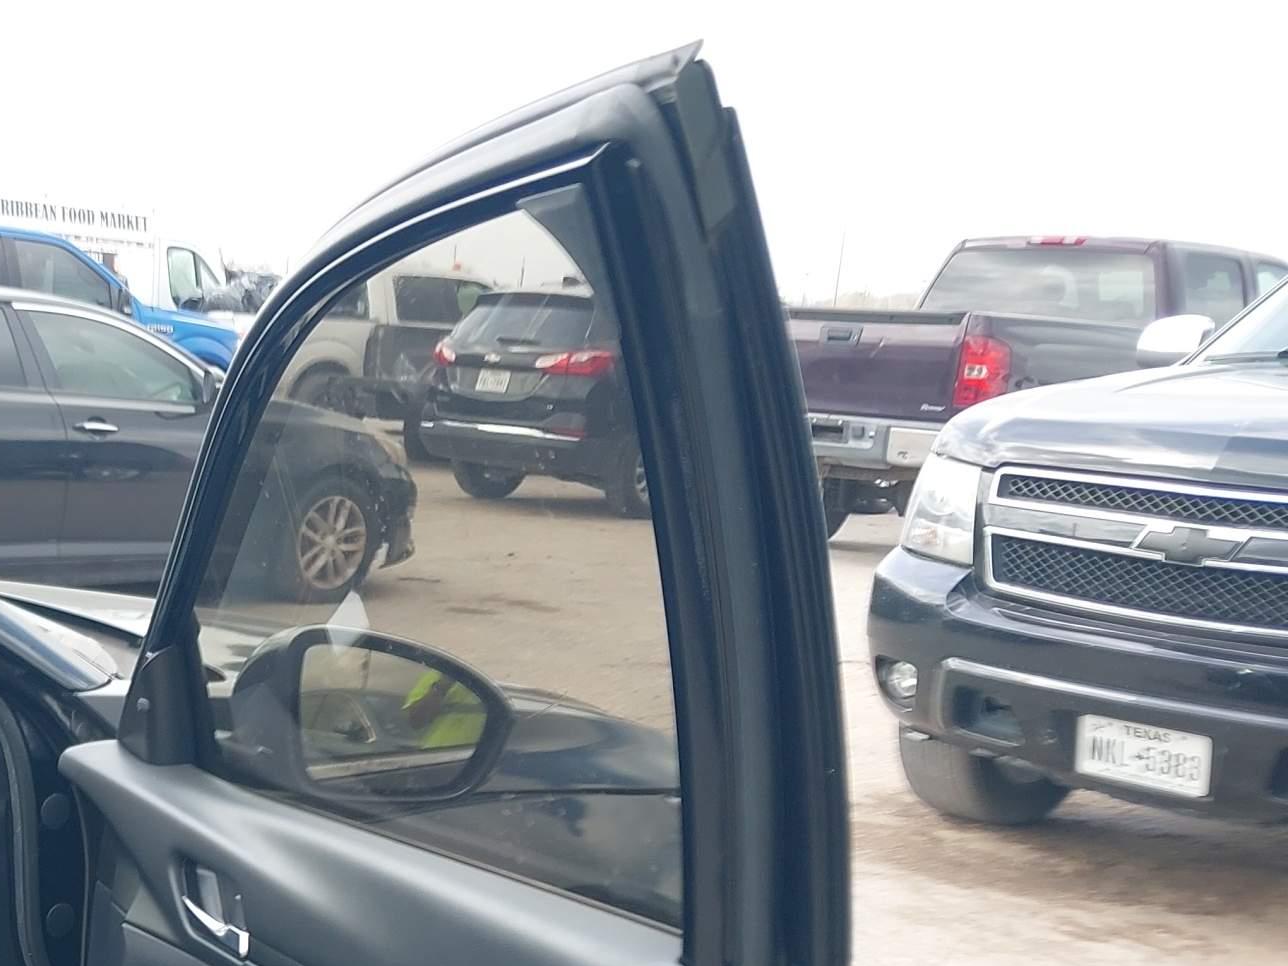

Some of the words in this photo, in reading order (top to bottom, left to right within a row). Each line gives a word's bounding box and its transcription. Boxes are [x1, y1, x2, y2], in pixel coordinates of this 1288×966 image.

[61, 206, 95, 225] FOOD
[100, 210, 148, 232] MARKET
[1123, 724, 1172, 744] TEXAS
